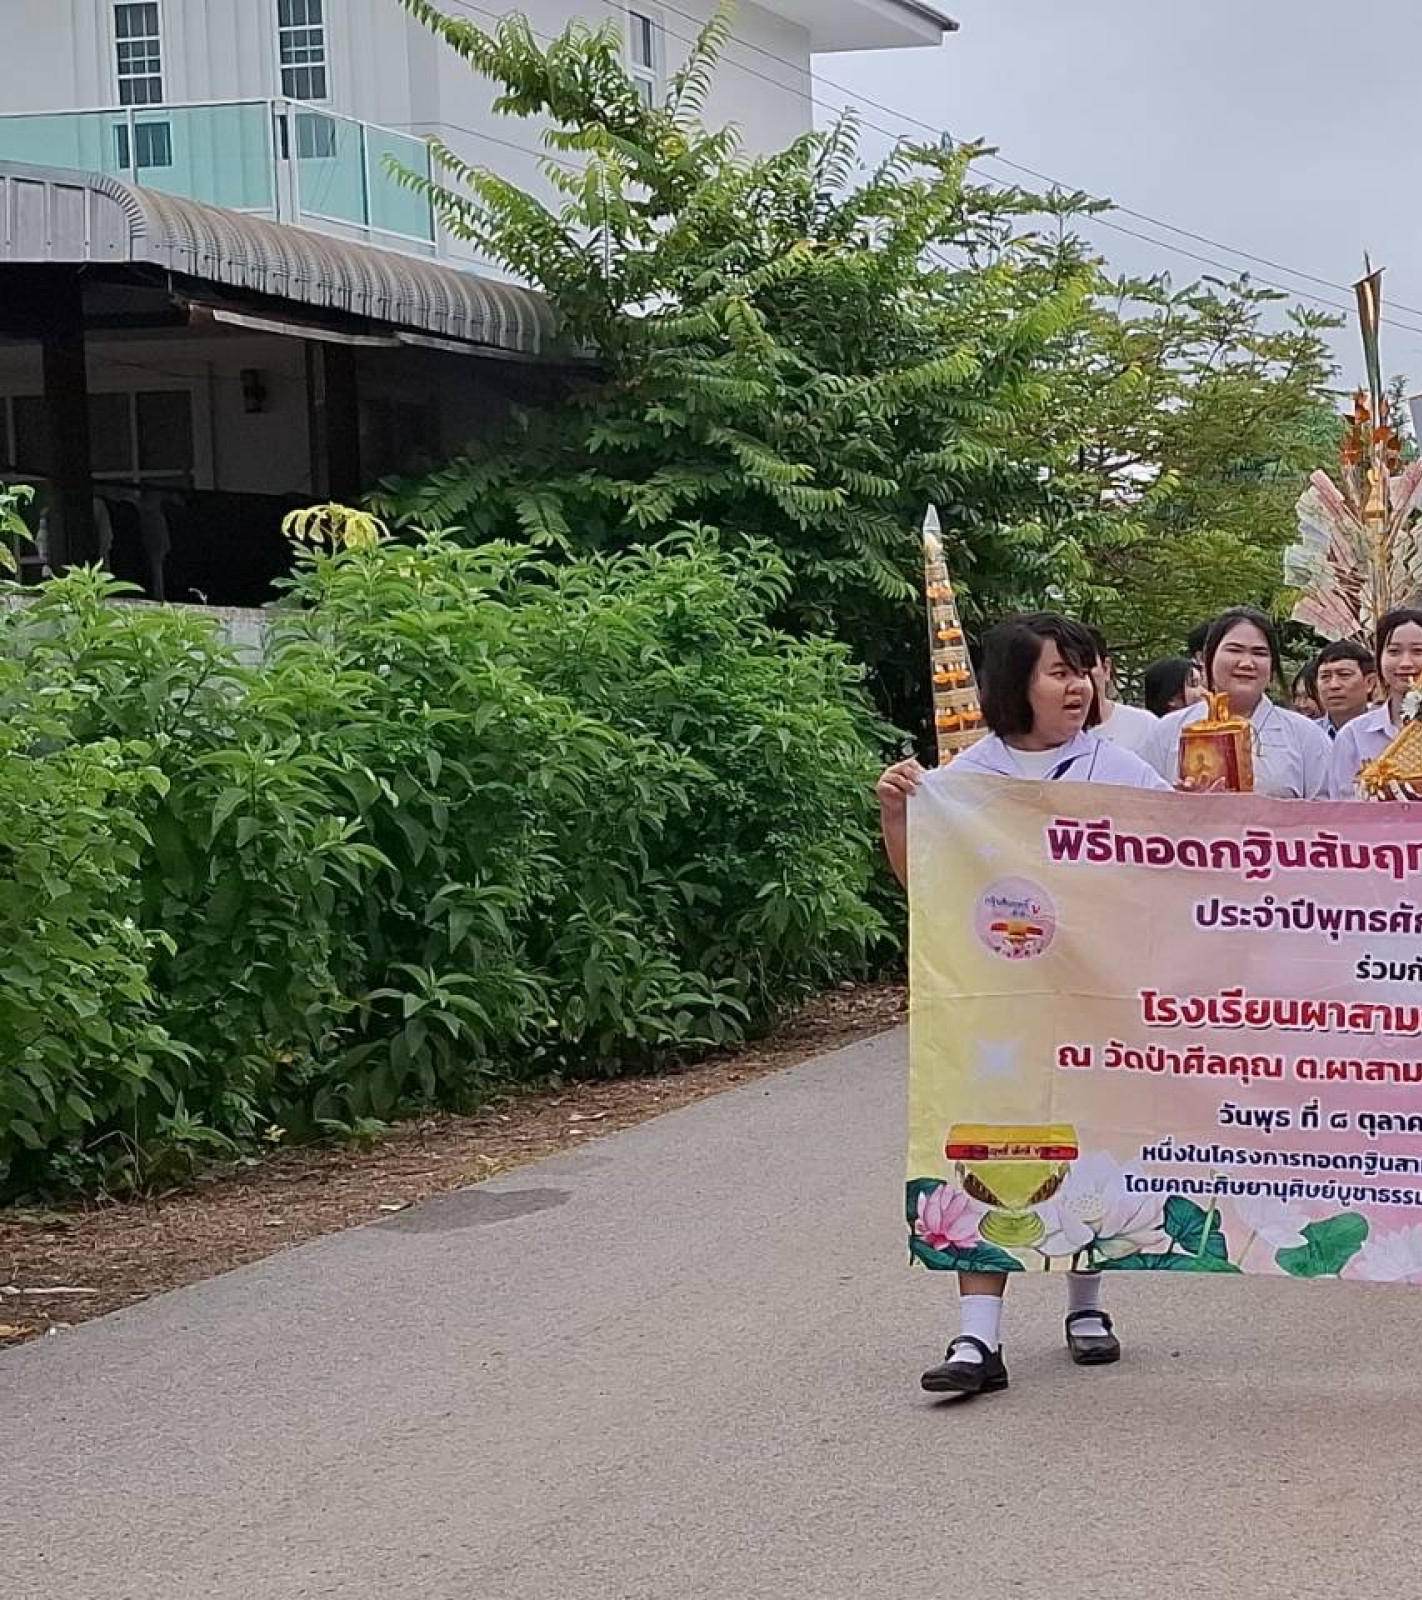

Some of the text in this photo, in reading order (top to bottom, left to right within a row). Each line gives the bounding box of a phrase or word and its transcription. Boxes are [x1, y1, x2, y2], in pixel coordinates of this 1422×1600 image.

[1059, 1045, 1091, 1068] ณ
[1104, 1040, 1283, 1083] วัดป่าศีลคุณ
[1219, 1102, 1291, 1133] วันพุธ
[1301, 1099, 1319, 1128] ที่
[1330, 1112, 1348, 1129] ๘
